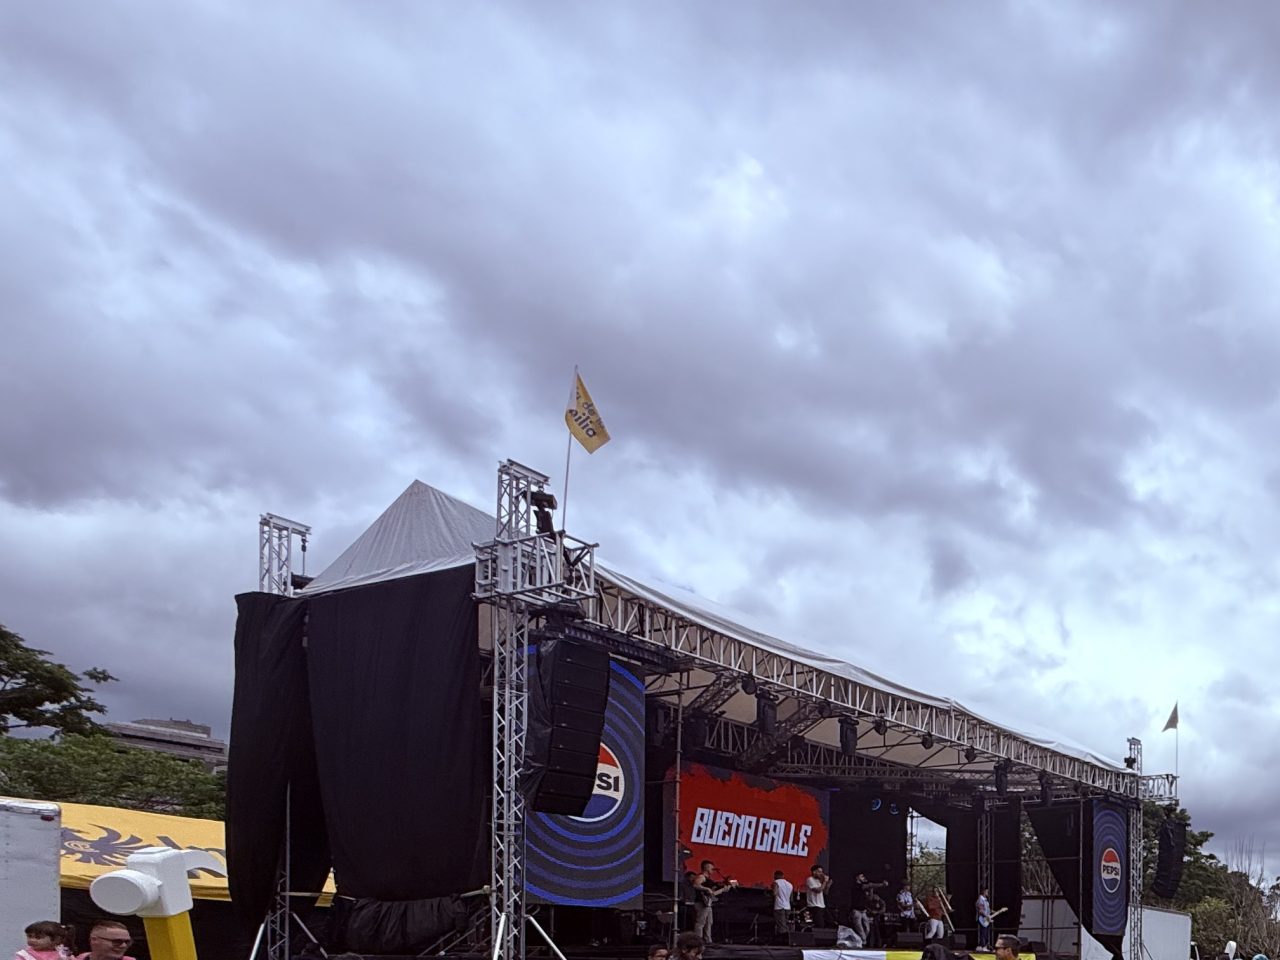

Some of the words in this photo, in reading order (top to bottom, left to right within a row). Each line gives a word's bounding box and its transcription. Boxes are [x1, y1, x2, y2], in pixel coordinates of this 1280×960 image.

[691, 807, 757, 850] BUENA
[755, 817, 812, 857] CALLE
[1103, 864, 1119, 876] PEPSI
